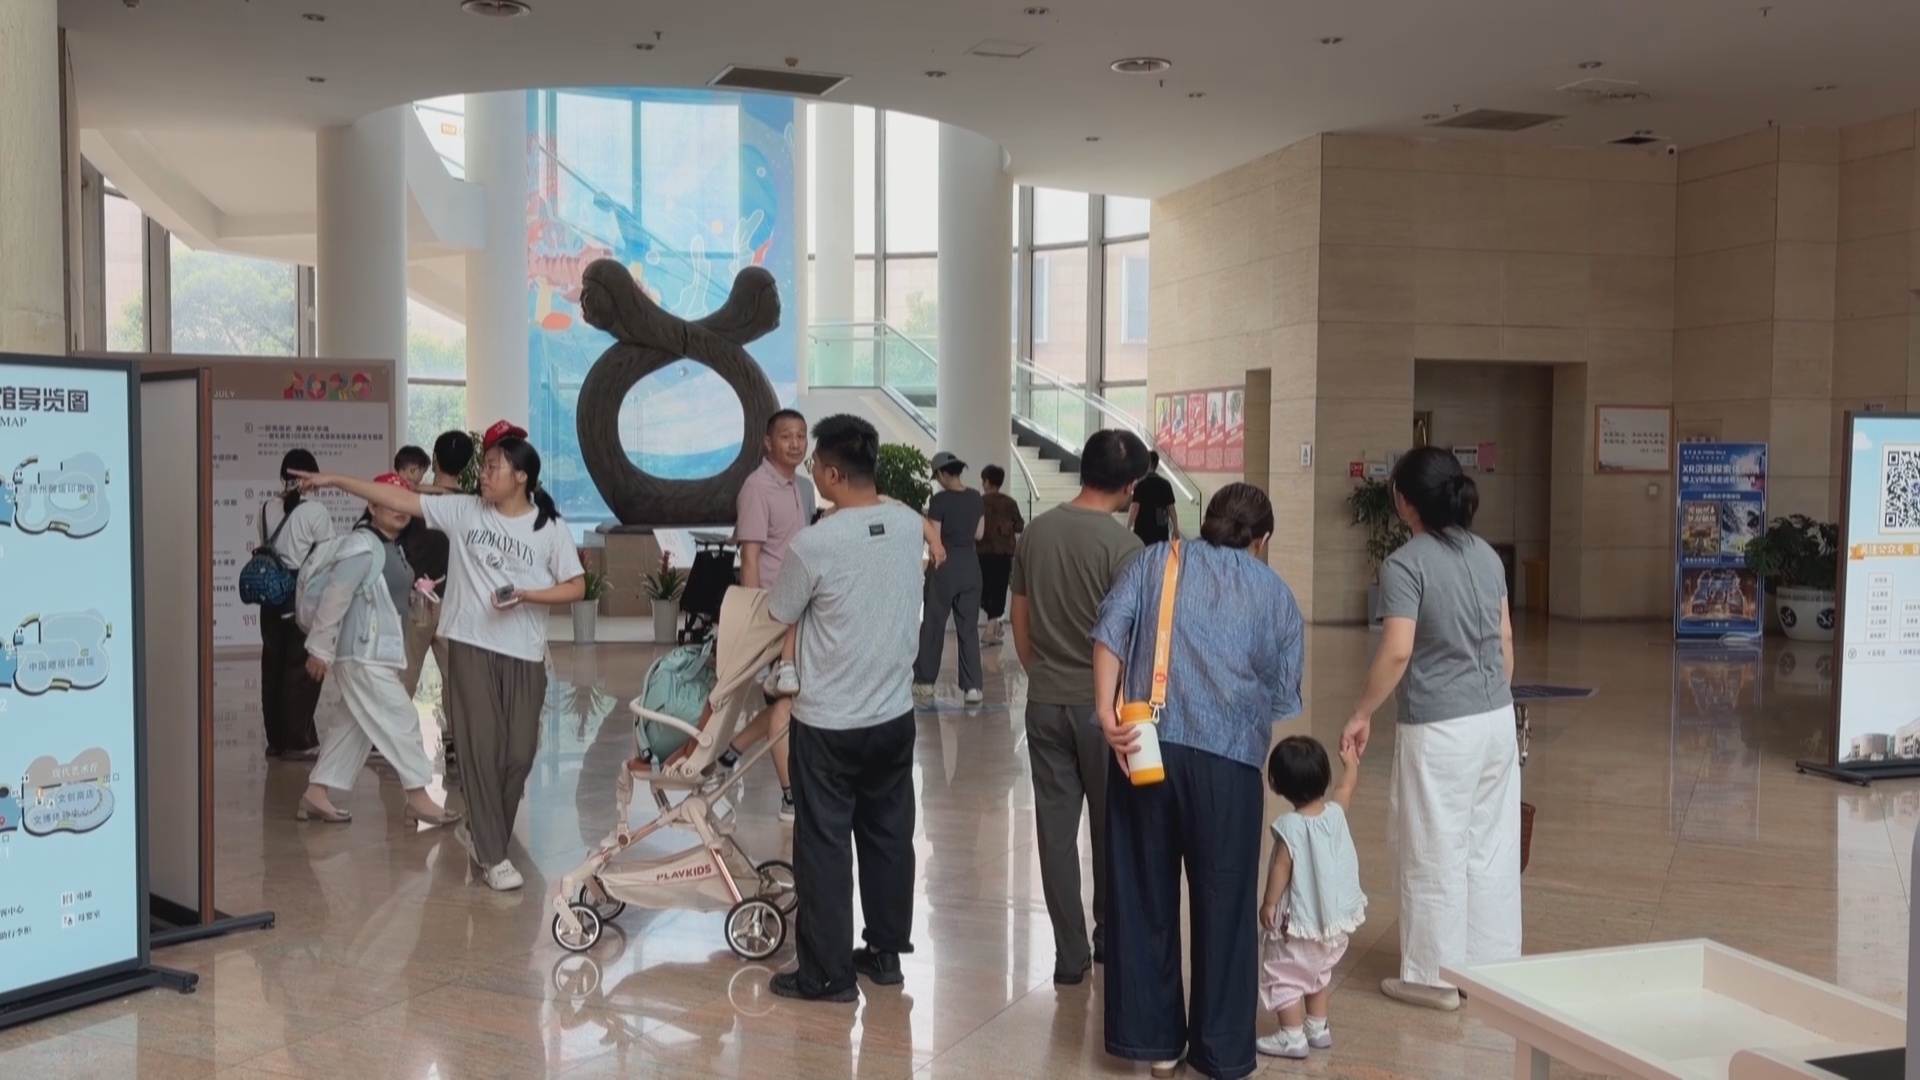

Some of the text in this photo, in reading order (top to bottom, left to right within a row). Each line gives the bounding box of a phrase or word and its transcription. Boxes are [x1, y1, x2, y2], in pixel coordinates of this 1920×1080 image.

[0, 385, 89, 413] 馆导览图
[213, 390, 236, 398] JULY
[0, 416, 27, 427] MAP
[466, 529, 535, 566] PERMANENTS
[29, 657, 94, 671] 中国雕版印刷馆
[103, 773, 120, 782] 出口
[656, 864, 712, 881] PLAYKIDS
